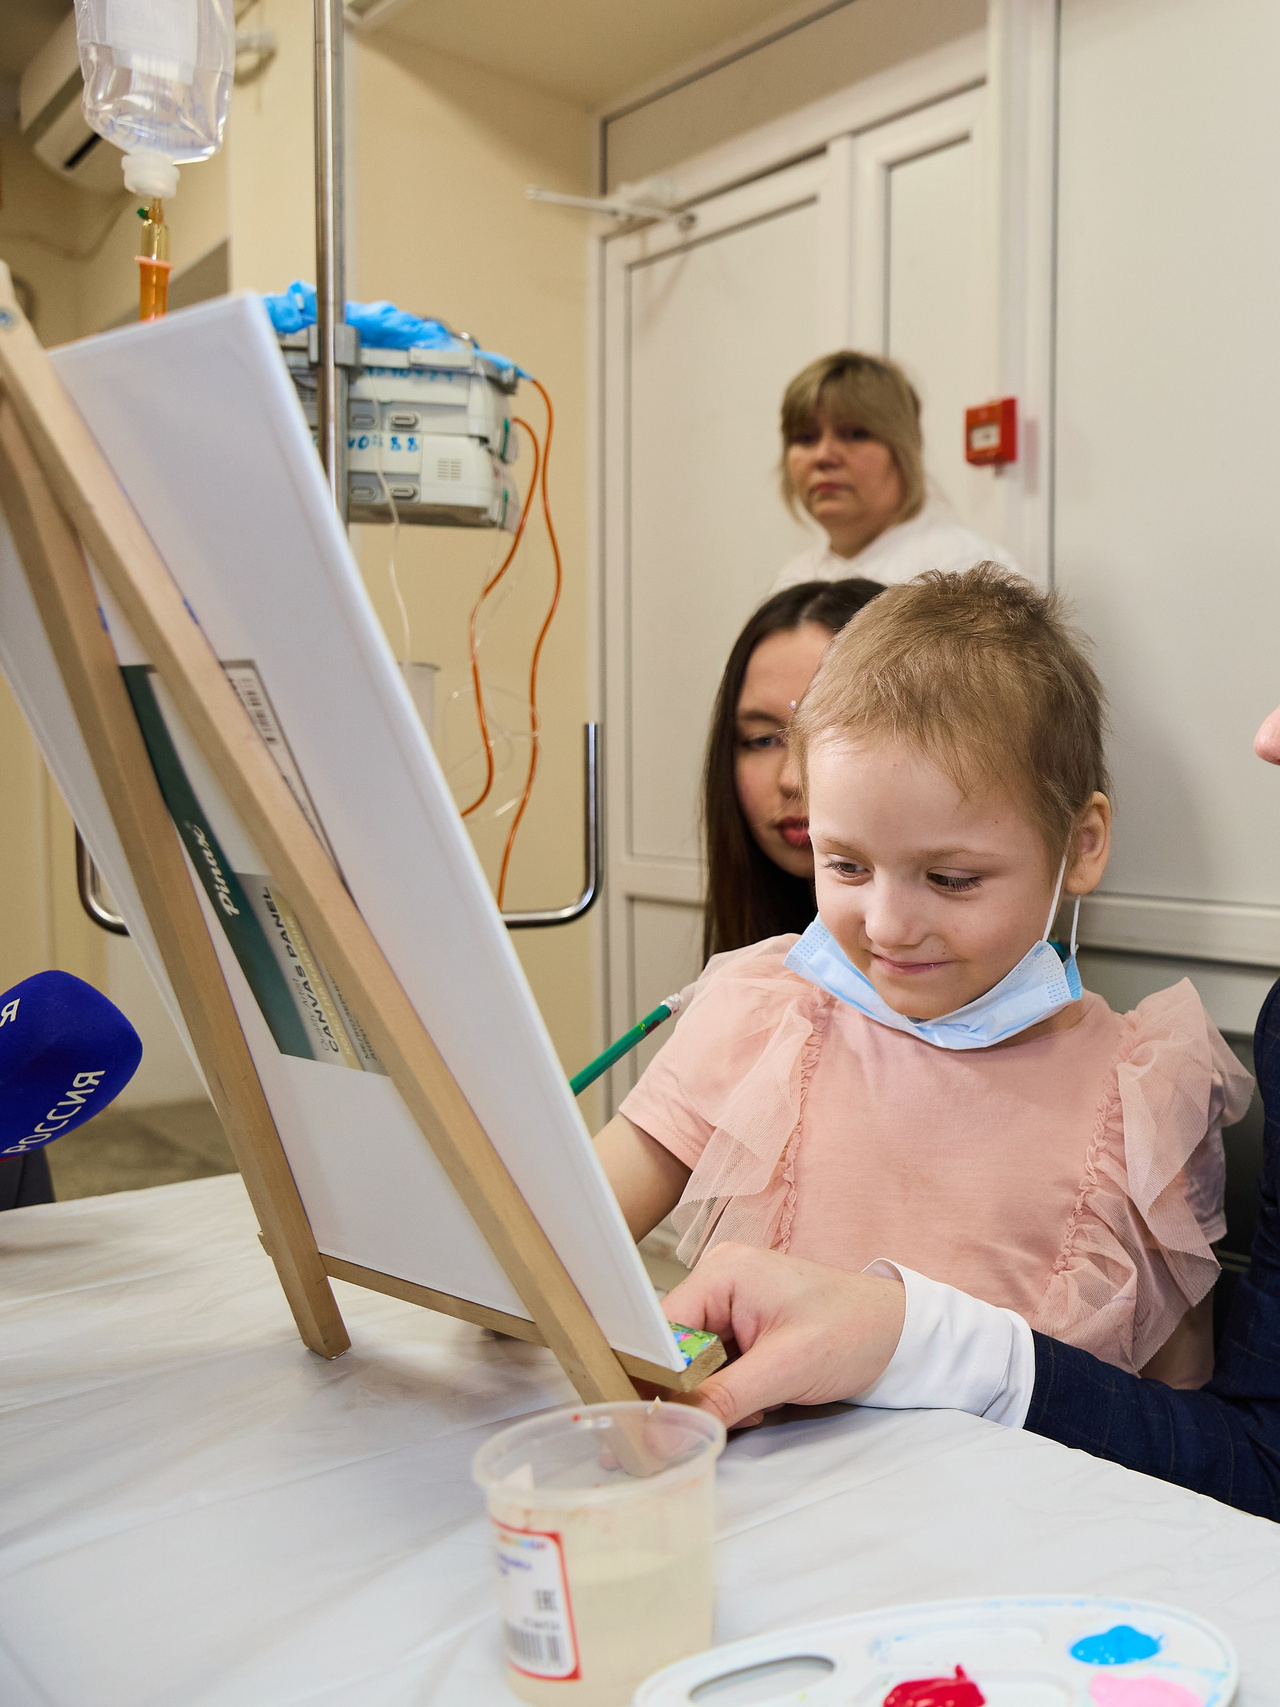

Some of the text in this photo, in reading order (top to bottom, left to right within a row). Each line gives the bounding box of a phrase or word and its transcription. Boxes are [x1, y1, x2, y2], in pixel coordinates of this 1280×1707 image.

[193, 824, 240, 916] Pinax
[263, 886, 339, 1053] CANVAS PANEL
[1, 1070, 106, 1154] РОССИЯ
